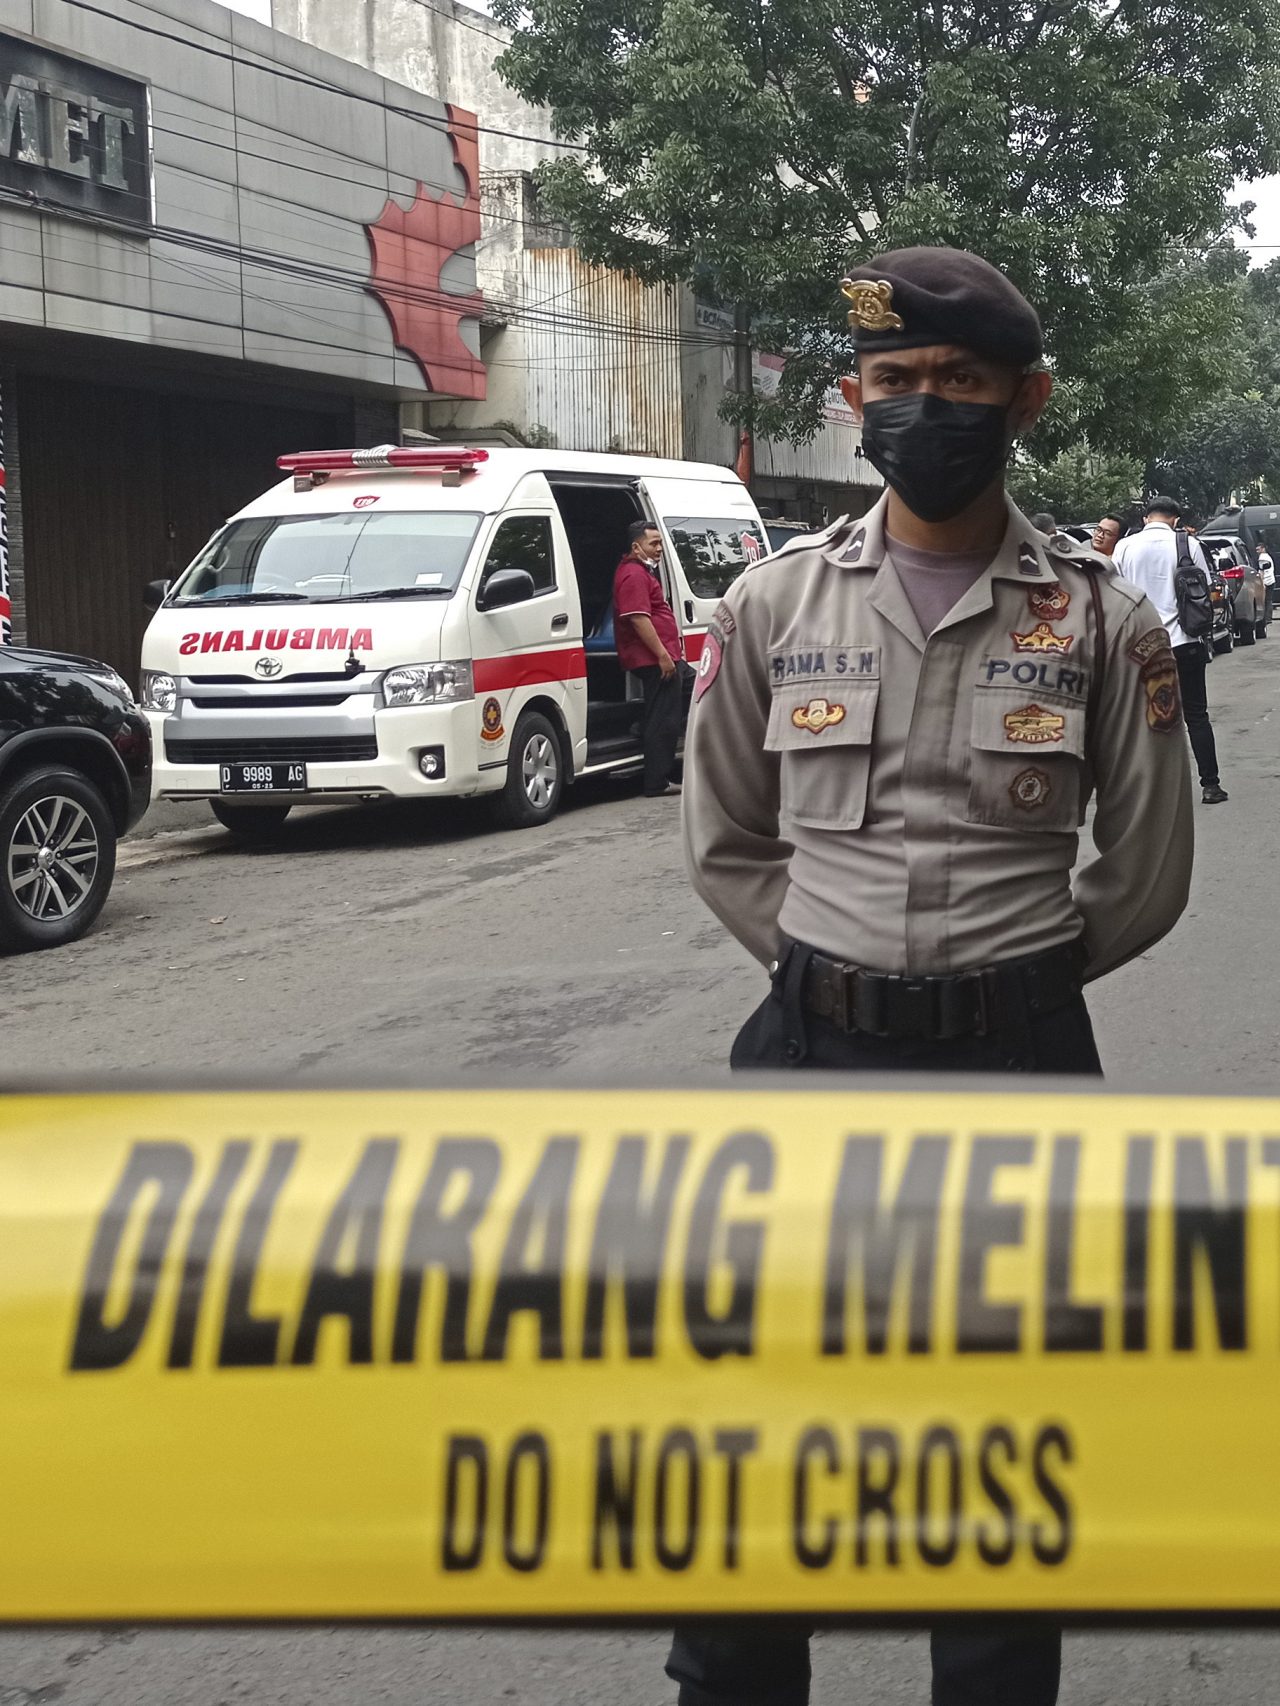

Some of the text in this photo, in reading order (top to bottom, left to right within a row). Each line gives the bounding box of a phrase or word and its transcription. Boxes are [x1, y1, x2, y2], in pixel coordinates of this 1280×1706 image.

[772, 653, 826, 679] RAMA
[986, 659, 1085, 695] POLRI
[223, 765, 303, 782] D 9989 AG
[67, 1129, 778, 1373] DILARANG
[438, 1420, 1076, 1574] DO NOT CROSS
